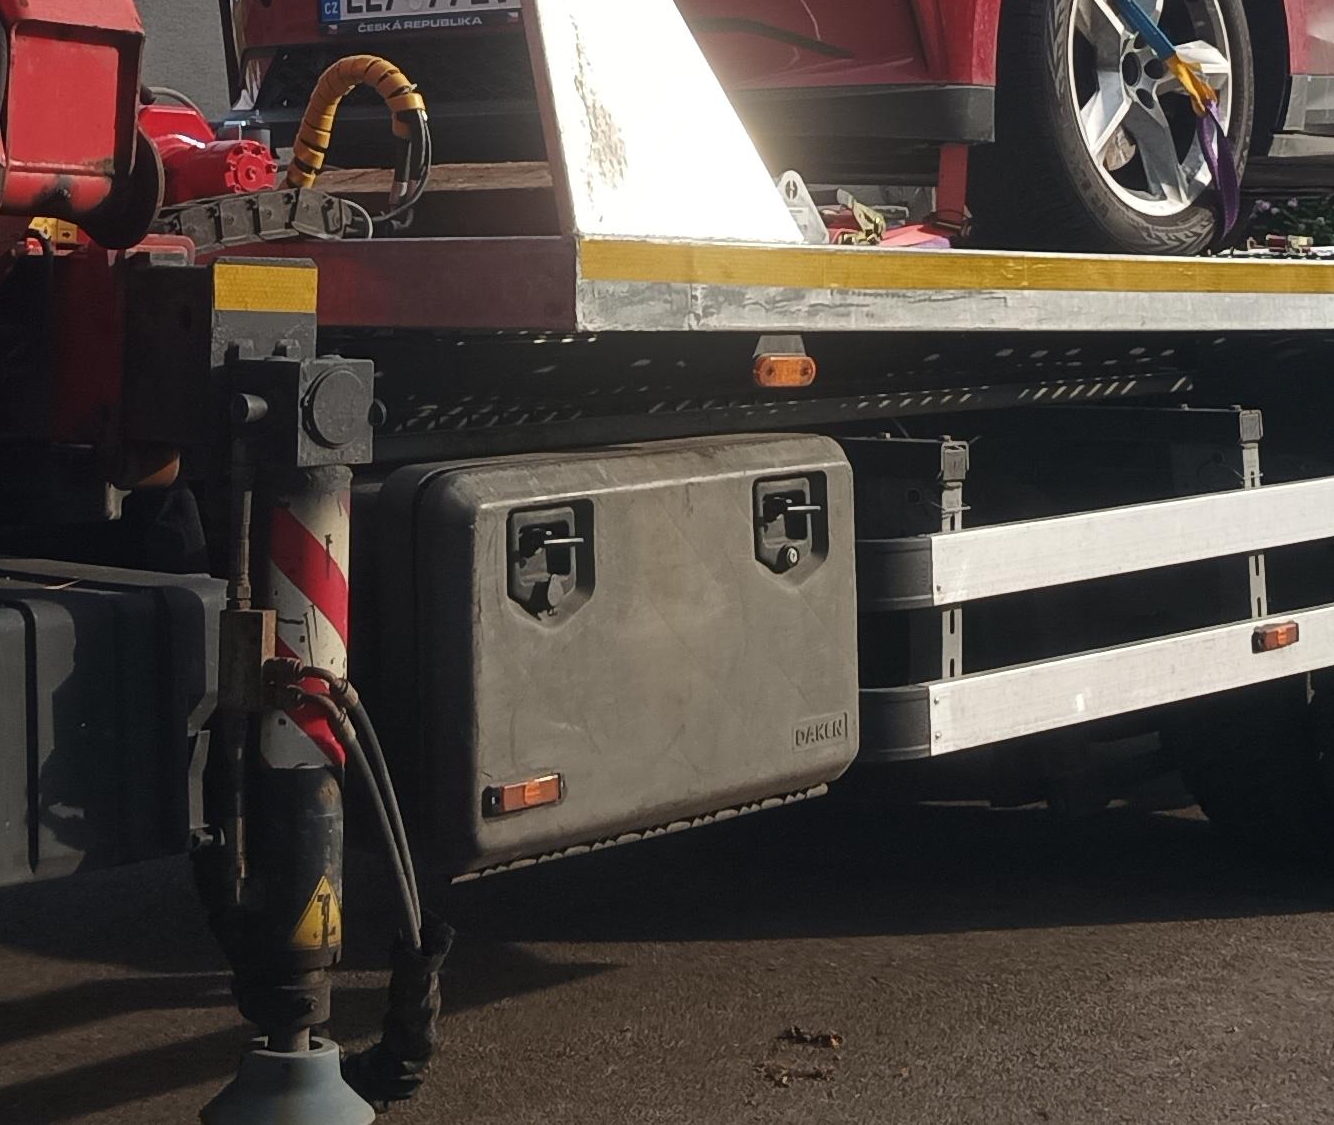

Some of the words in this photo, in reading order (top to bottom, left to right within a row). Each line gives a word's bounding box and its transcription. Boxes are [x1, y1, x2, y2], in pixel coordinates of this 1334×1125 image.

[324, 1, 339, 14] CZ
[357, 20, 402, 33] ČESKÁ
[403, 16, 483, 30] REPUBLIKA
